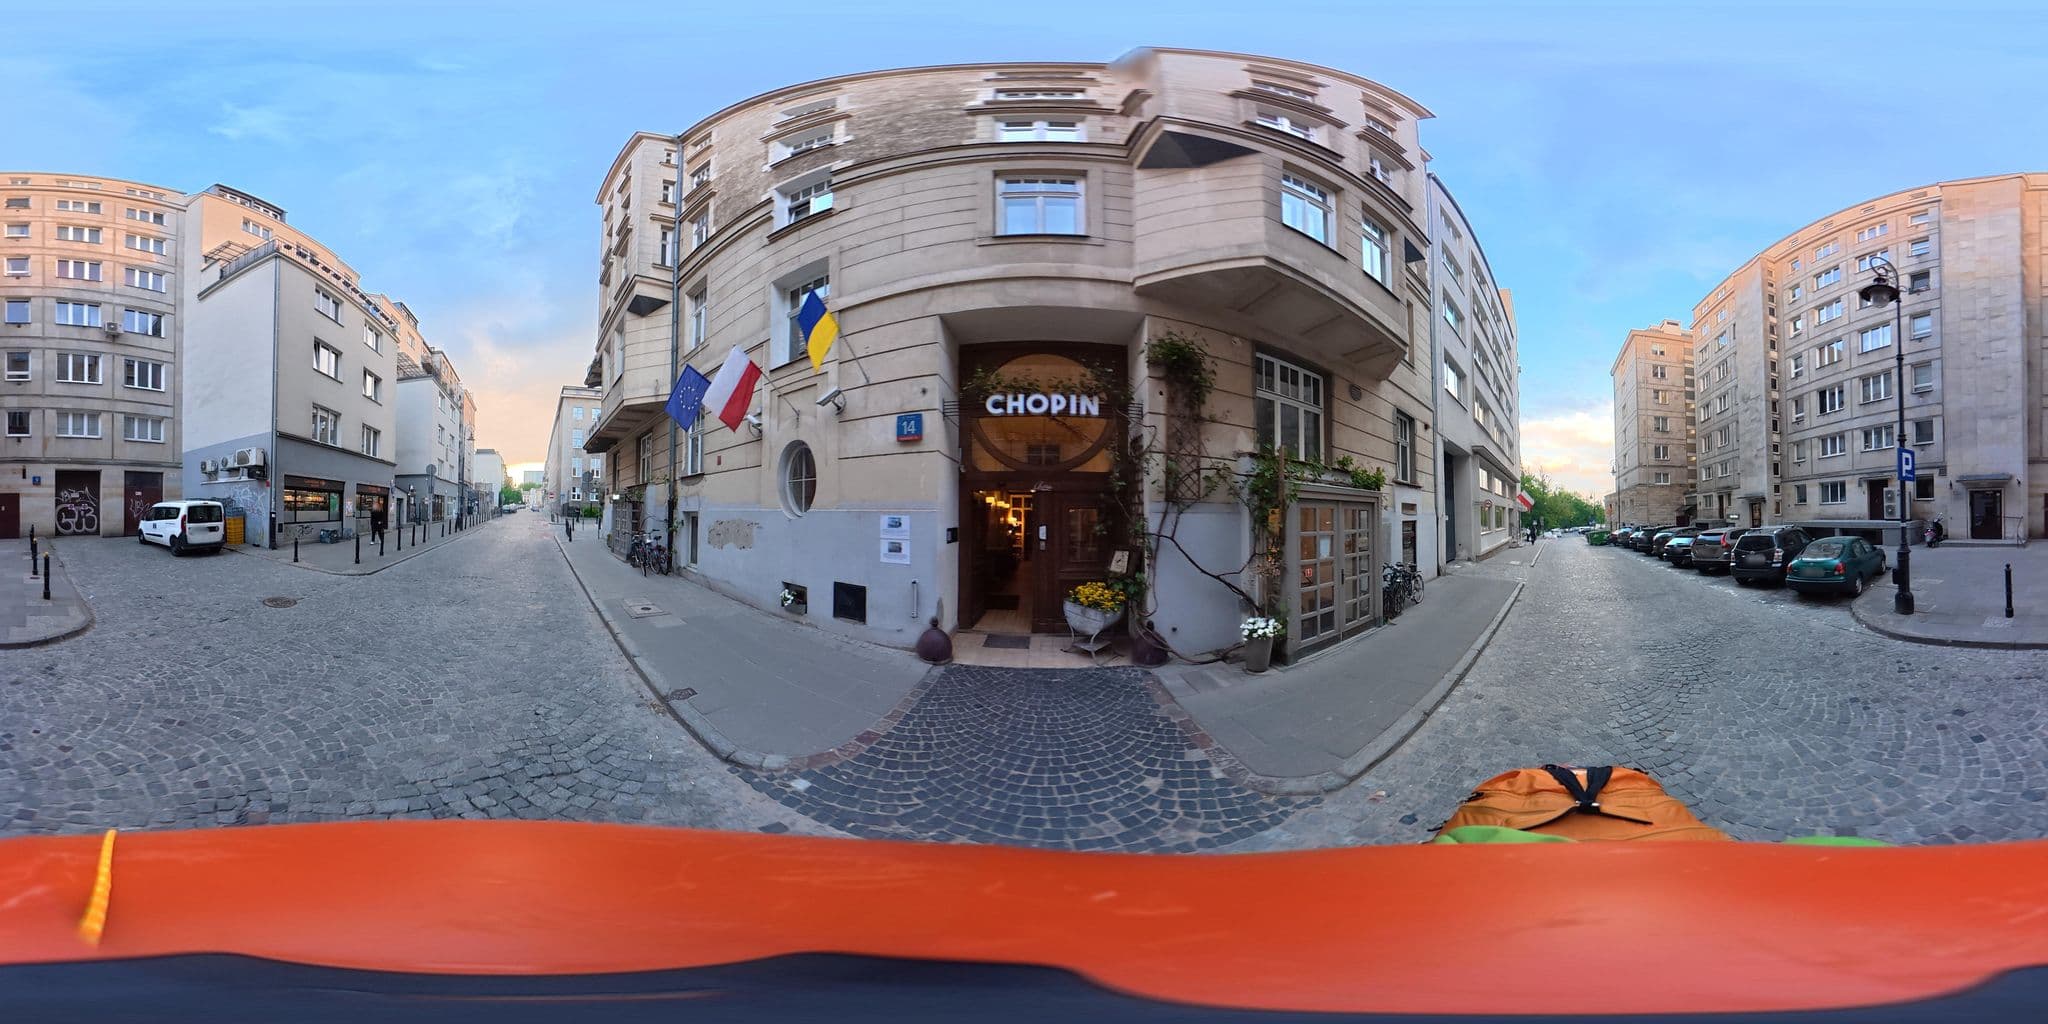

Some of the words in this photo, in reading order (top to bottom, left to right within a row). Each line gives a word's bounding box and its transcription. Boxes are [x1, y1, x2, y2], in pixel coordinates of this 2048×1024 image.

[985, 393, 1100, 416] CHOPIN
[902, 420, 917, 435] 14
[1902, 452, 1912, 477] P
